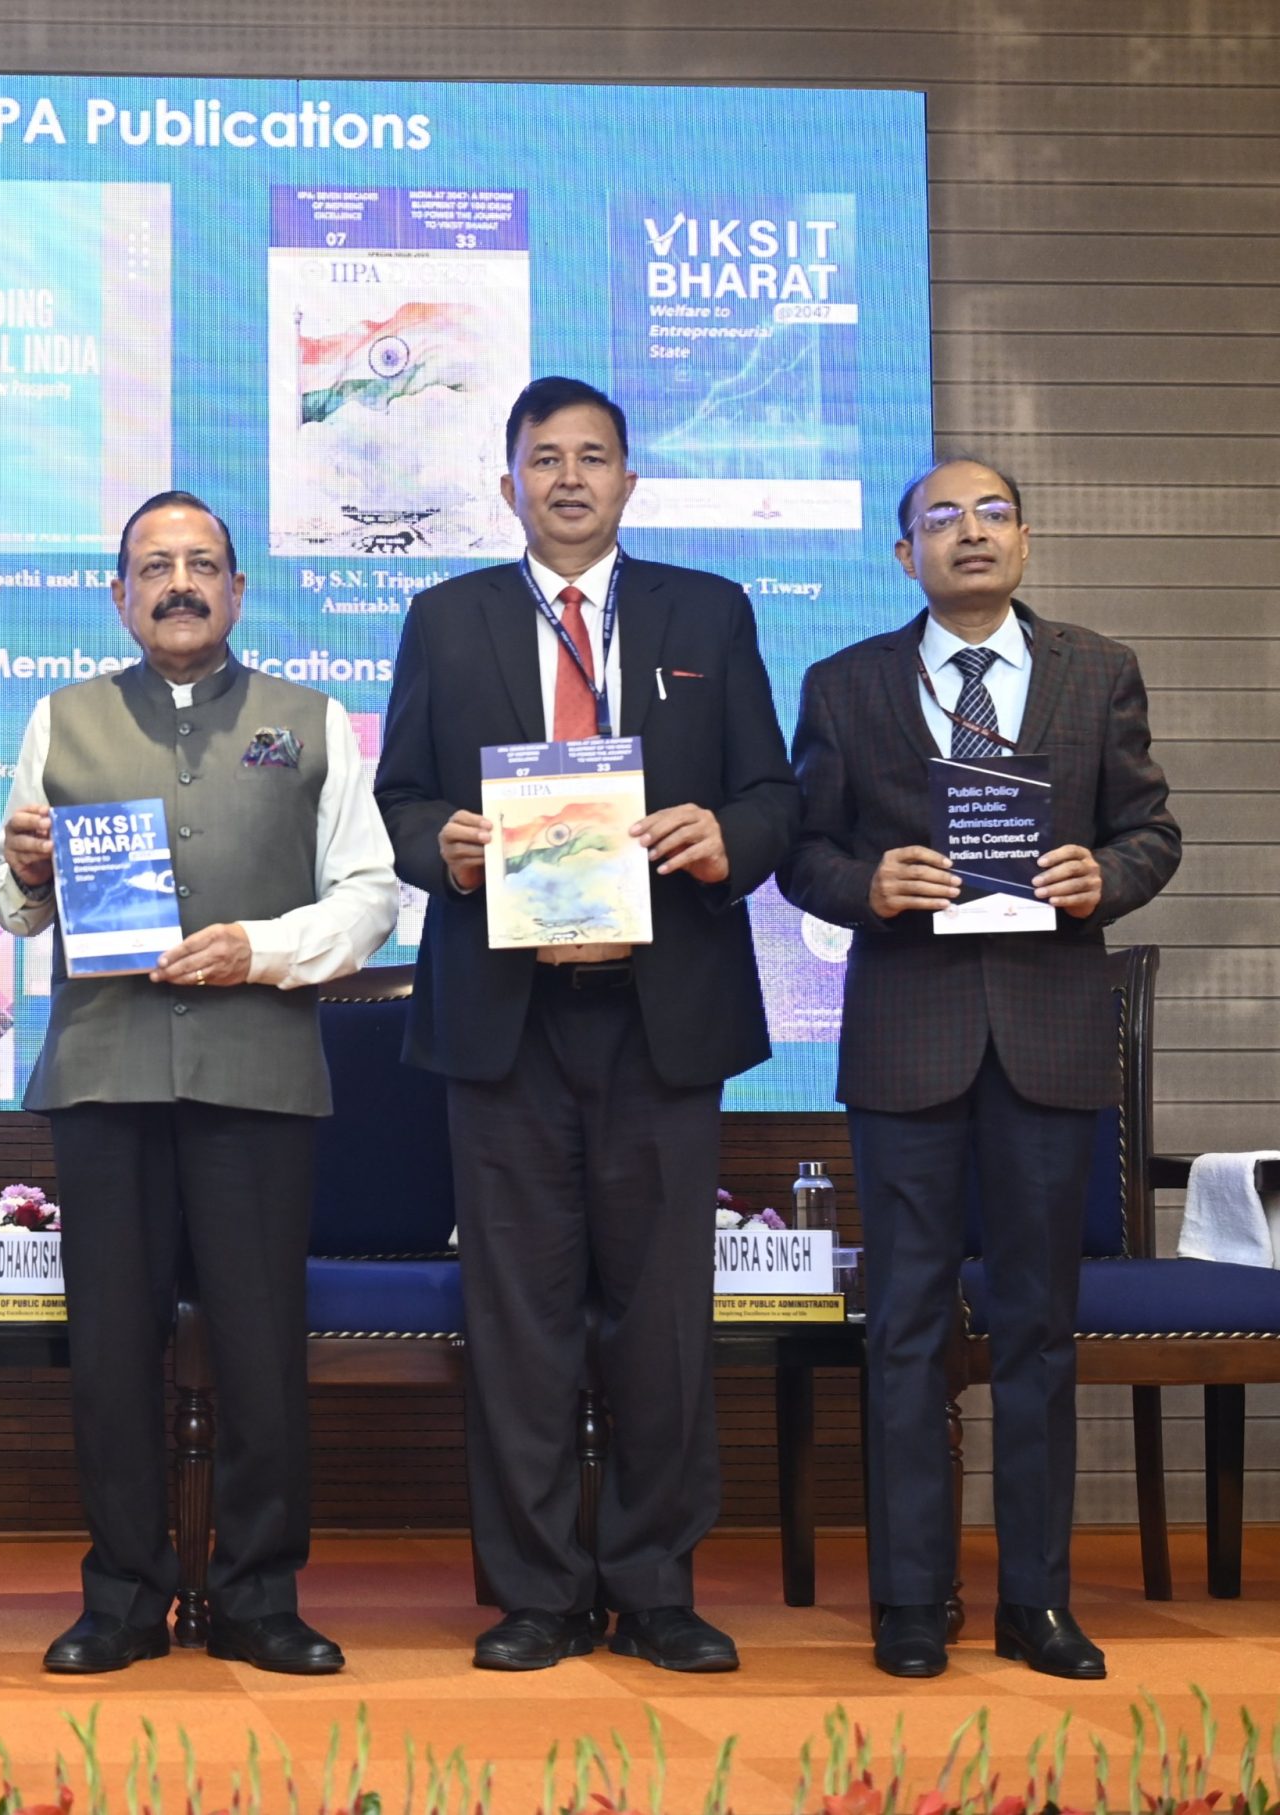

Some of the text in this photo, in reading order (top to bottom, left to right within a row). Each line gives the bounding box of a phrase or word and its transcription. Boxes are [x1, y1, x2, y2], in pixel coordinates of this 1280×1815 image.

[87, 98, 431, 150] Publications
[326, 231, 347, 247] 07
[455, 233, 477, 249] 33
[644, 213, 837, 259] VIKSIT
[331, 263, 381, 283] IIPA
[648, 262, 838, 299] BHARAT
[650, 304, 731, 317] Welfare to
[778, 305, 831, 320] @2047
[649, 324, 773, 340] Entrepreneurial
[24, 335, 100, 375] INDIA
[649, 344, 691, 358] State
[46, 570, 79, 587] and
[301, 569, 451, 594] By S.N. Tripathi
[756, 577, 822, 600] Tiwary
[322, 597, 401, 614] Amitabh
[516, 768, 530, 777] 07
[596, 763, 611, 772] 33
[520, 784, 552, 797] IIPA
[947, 785, 1019, 797] Public Policy
[948, 802, 1007, 813] and Public
[64, 812, 154, 837] VIKSIT
[949, 816, 1035, 829] Administration:
[69, 832, 156, 856] BHARAT
[949, 832, 1040, 845] In the Context of
[949, 849, 1039, 860] Indian Literature
[766, 1236, 812, 1272] SINGH
[0, 1299, 10, 1308] OF
[13, 1299, 39, 1308] PUBLIC
[738, 1300, 747, 1308] OF
[750, 1300, 776, 1308] PUBLIC
[778, 1300, 839, 1308] ADMINISTRATION
